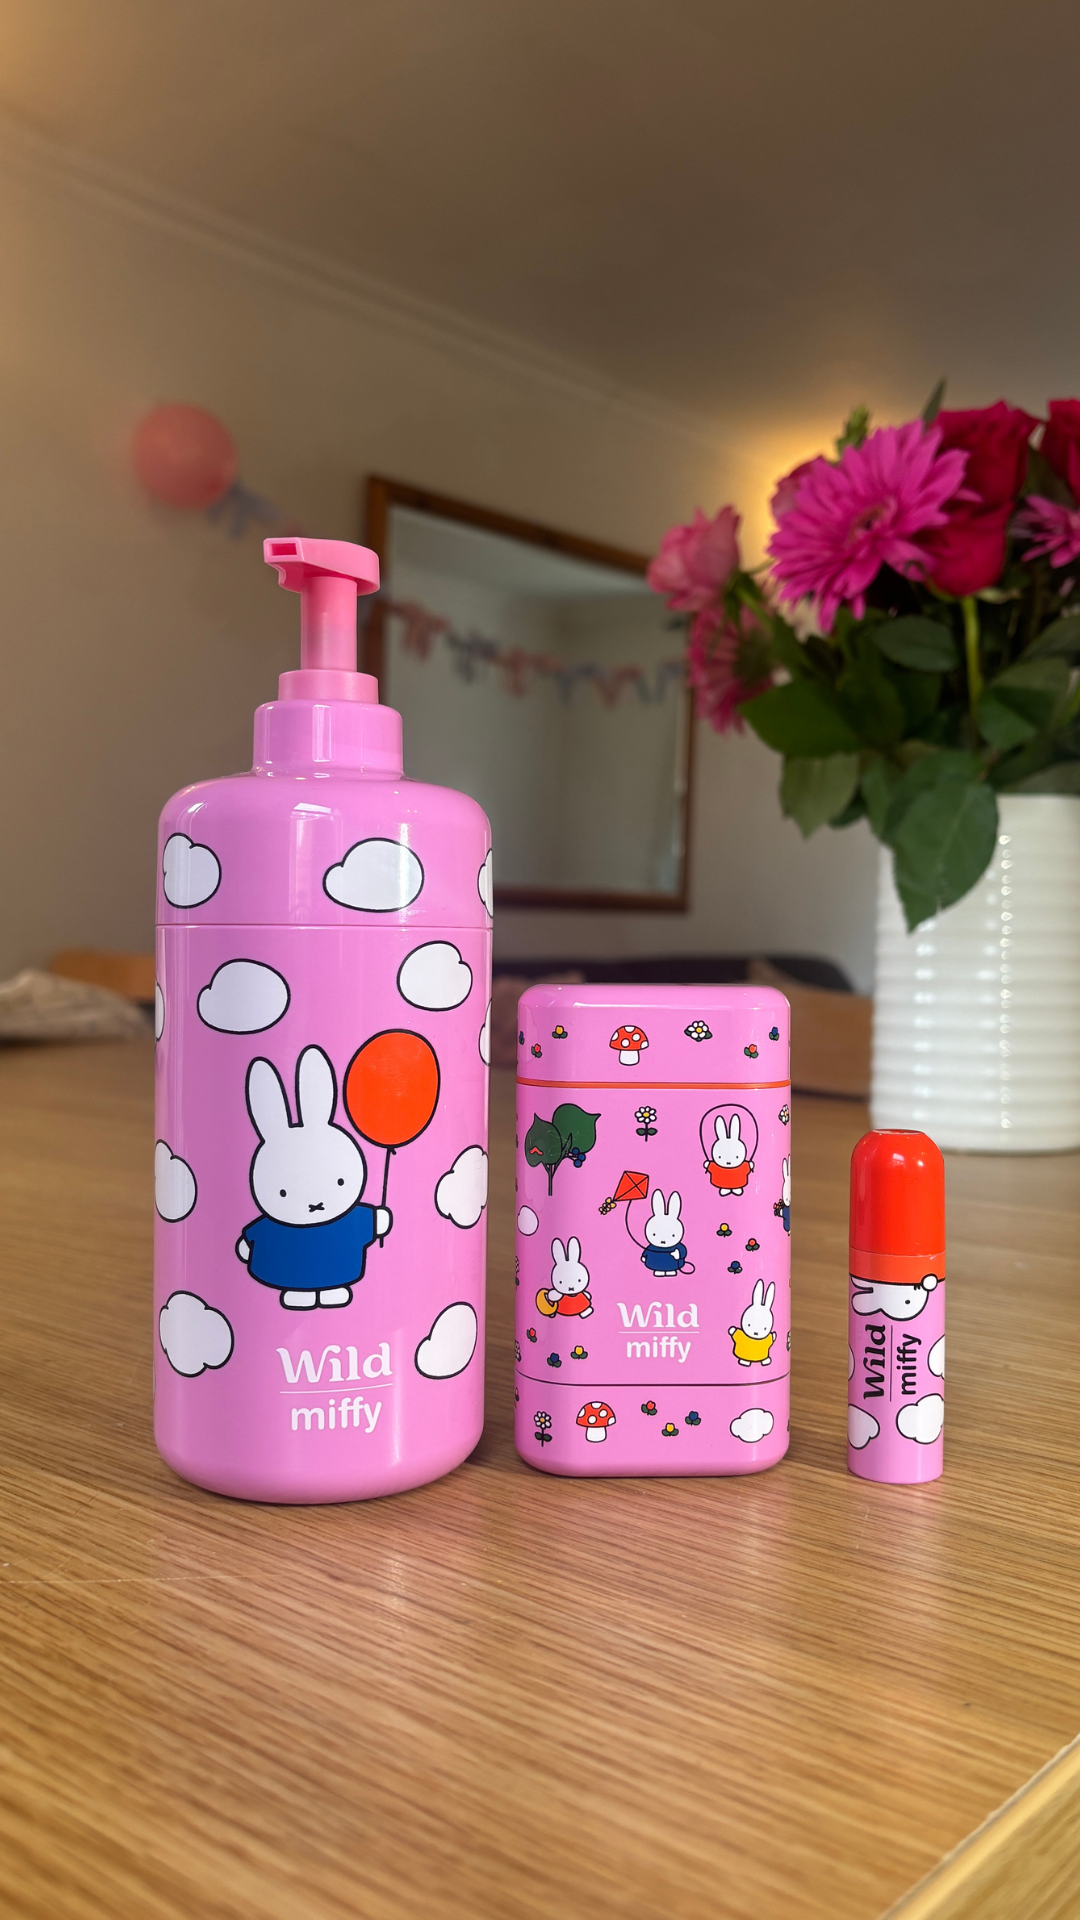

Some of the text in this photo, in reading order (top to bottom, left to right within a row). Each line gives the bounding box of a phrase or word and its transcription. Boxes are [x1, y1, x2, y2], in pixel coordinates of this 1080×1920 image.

[616, 1302, 699, 1329] Wild
[276, 1342, 393, 1384] Wild
[626, 1335, 692, 1363] miffy
[863, 1324, 886, 1400] Wild
[897, 1333, 922, 1396] miffy
[291, 1396, 383, 1434] miffy
